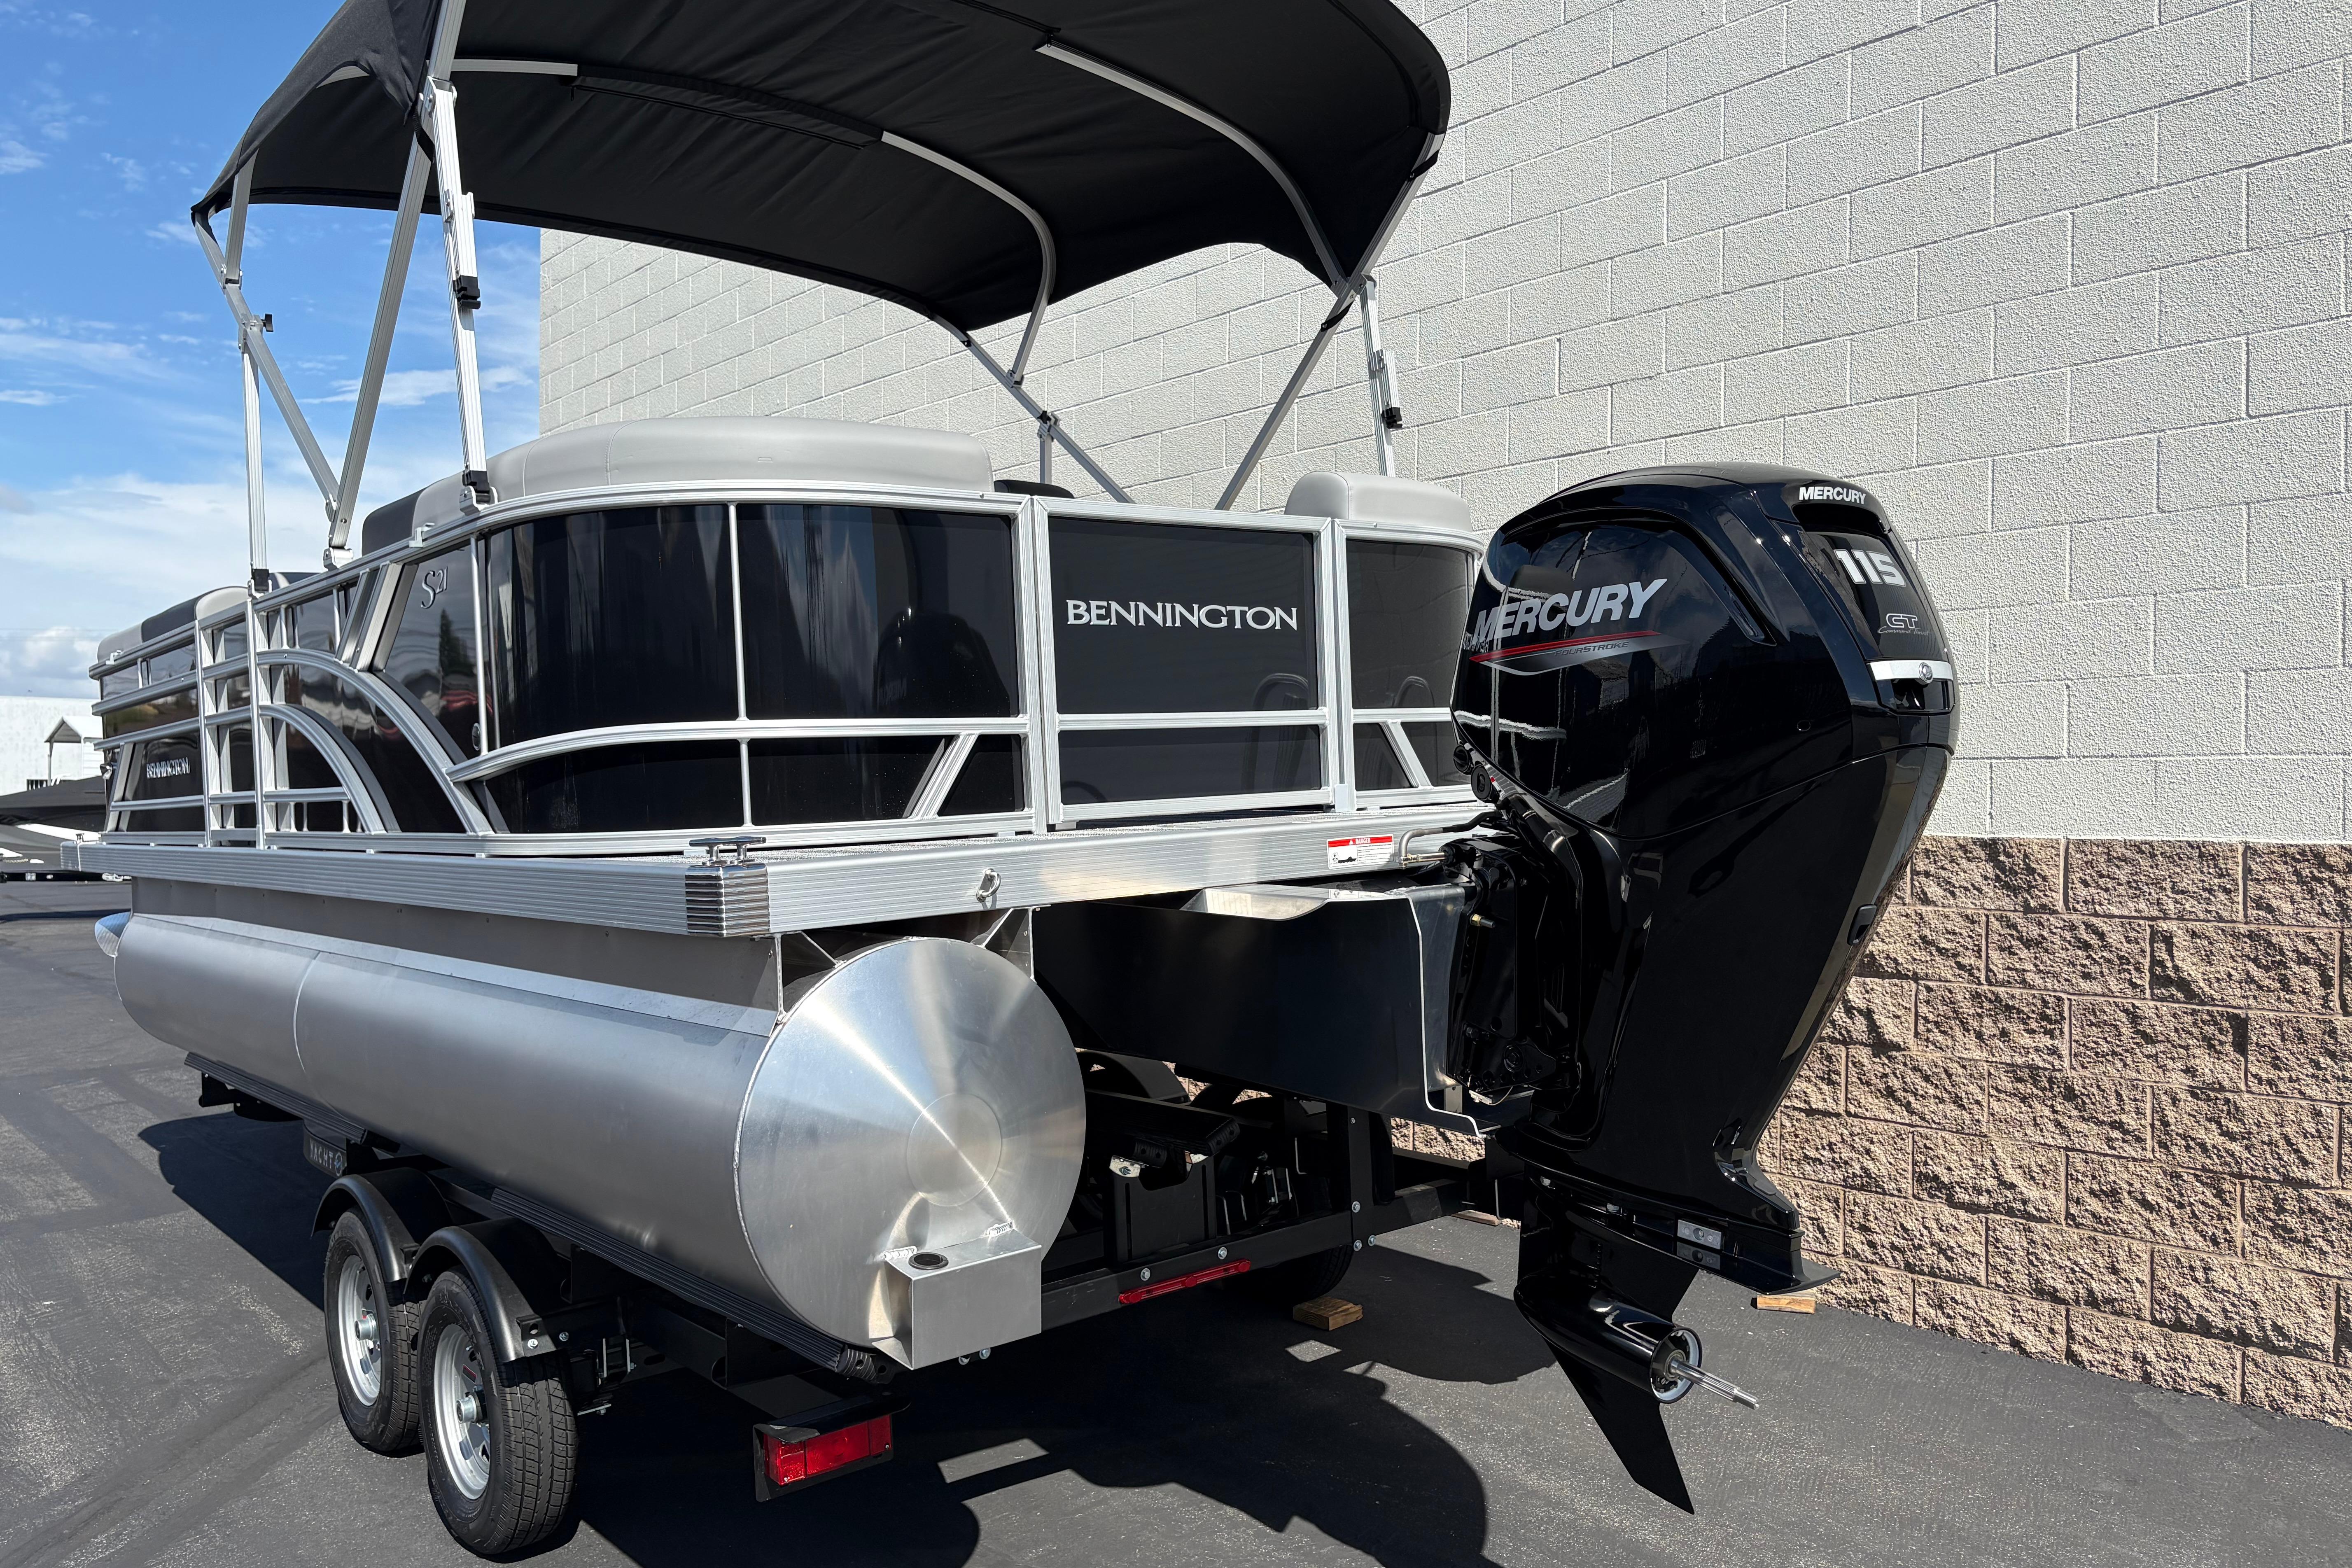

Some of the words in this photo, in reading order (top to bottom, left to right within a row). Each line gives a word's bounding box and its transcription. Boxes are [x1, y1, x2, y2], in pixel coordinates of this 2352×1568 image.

[1799, 486, 1866, 505] MERCURY
[1833, 549, 1907, 587] 115
[1066, 600, 1297, 631] BENNINGTON
[1473, 578, 1667, 645] MERCURY
[1913, 628, 1929, 636] Thrust
[146, 757, 190, 779] BENNINGTON
[310, 1138, 333, 1169] YACHT
